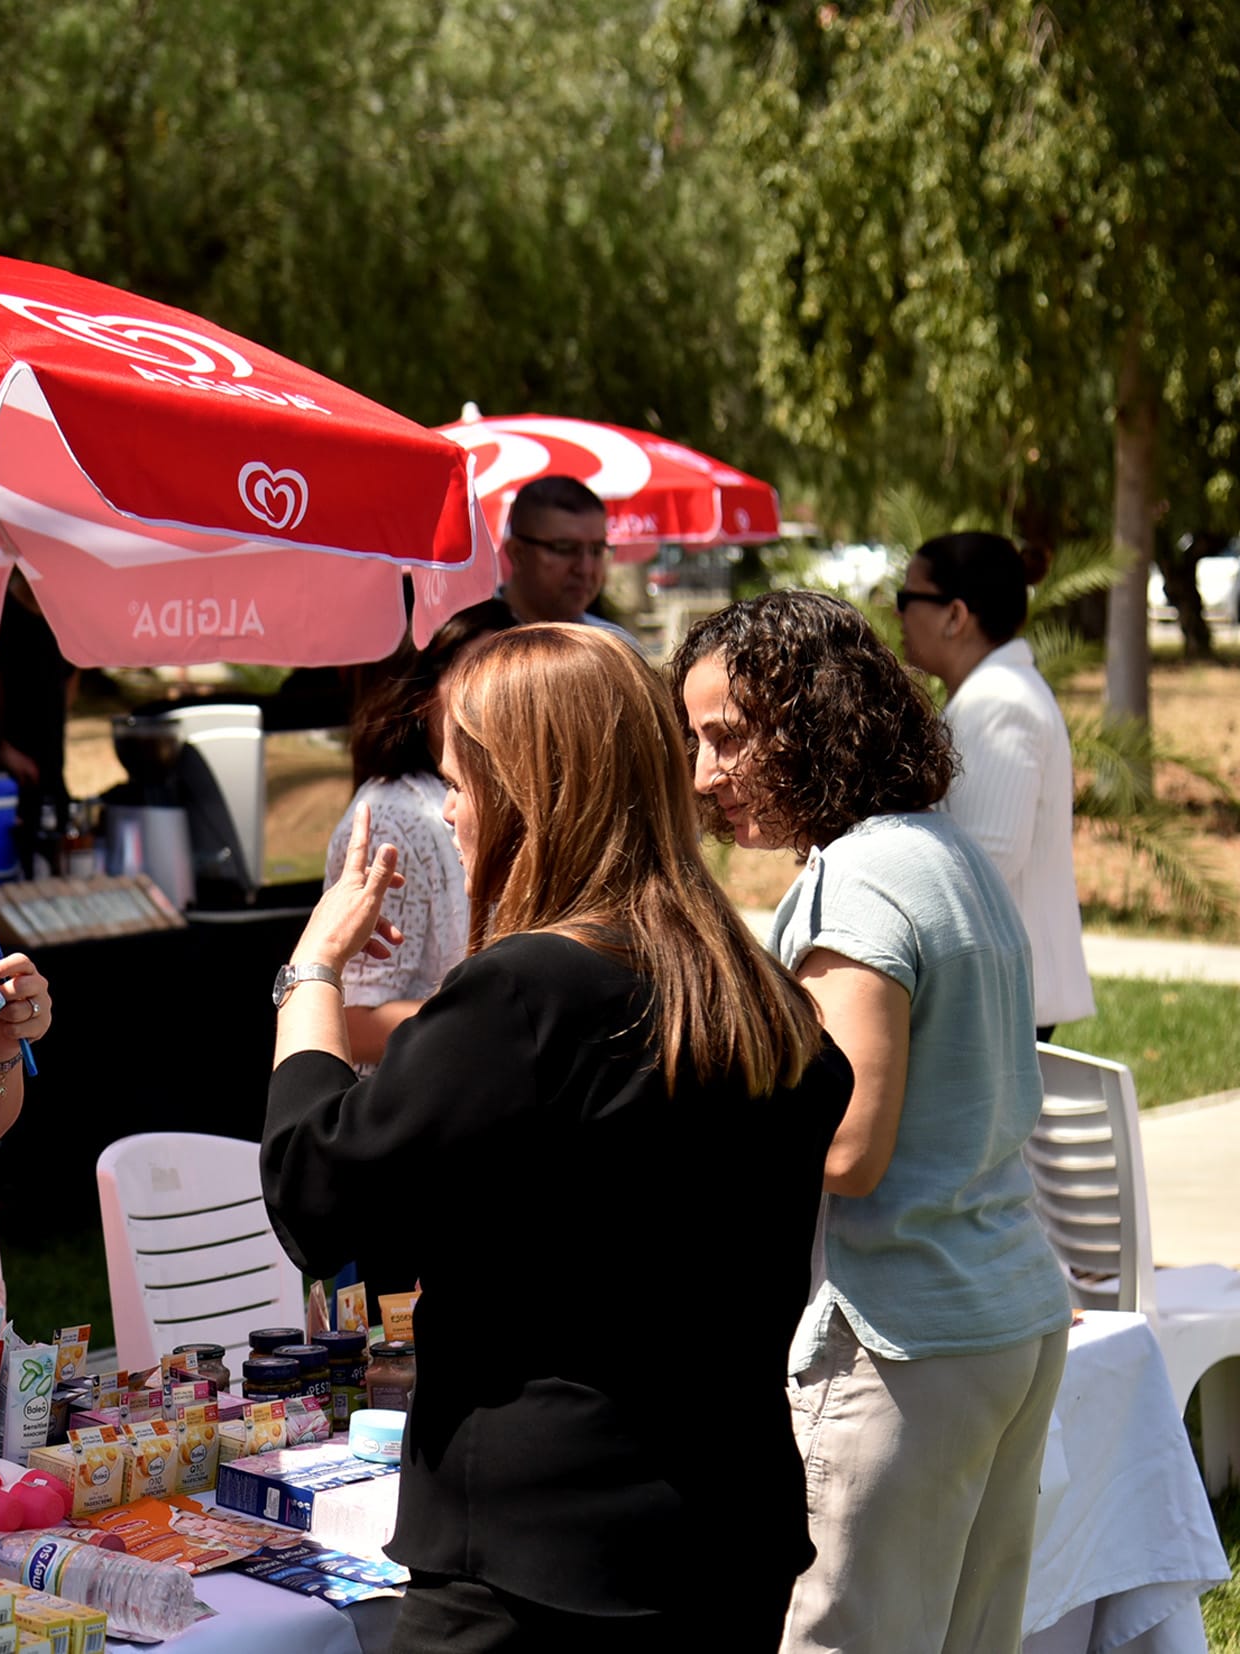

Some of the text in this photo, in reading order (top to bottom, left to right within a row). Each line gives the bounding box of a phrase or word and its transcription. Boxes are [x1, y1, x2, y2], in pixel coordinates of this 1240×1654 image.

[26, 1402, 46, 1415] Balea
[32, 1545, 53, 1588] mey su
